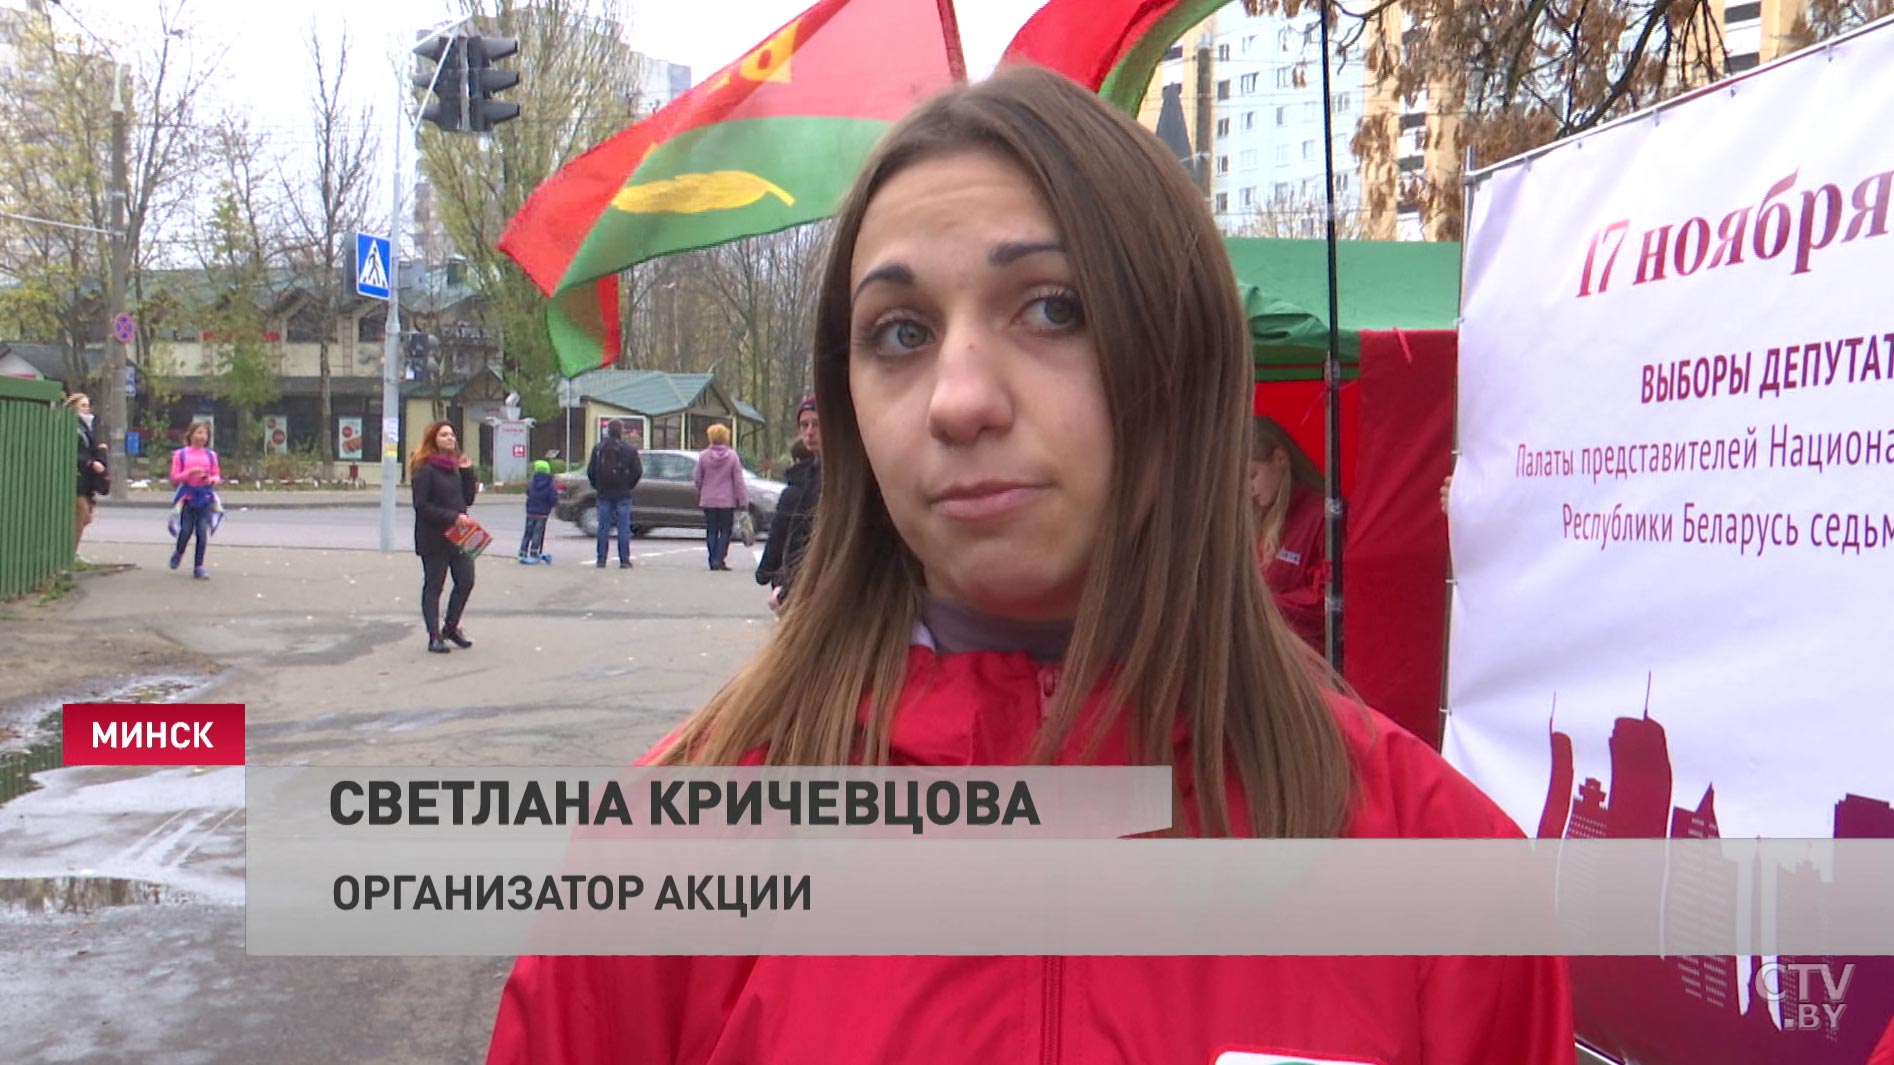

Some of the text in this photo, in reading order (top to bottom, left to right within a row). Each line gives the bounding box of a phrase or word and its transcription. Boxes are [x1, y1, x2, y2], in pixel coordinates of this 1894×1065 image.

[1576, 165, 1894, 298] 17 ноября
[1642, 352, 1751, 403] ВЫБОРЫ
[1516, 443, 1574, 478] Палаты
[1581, 426, 1757, 484] представителей
[1562, 503, 1673, 551] Республики
[1683, 502, 1799, 557] Беларусь
